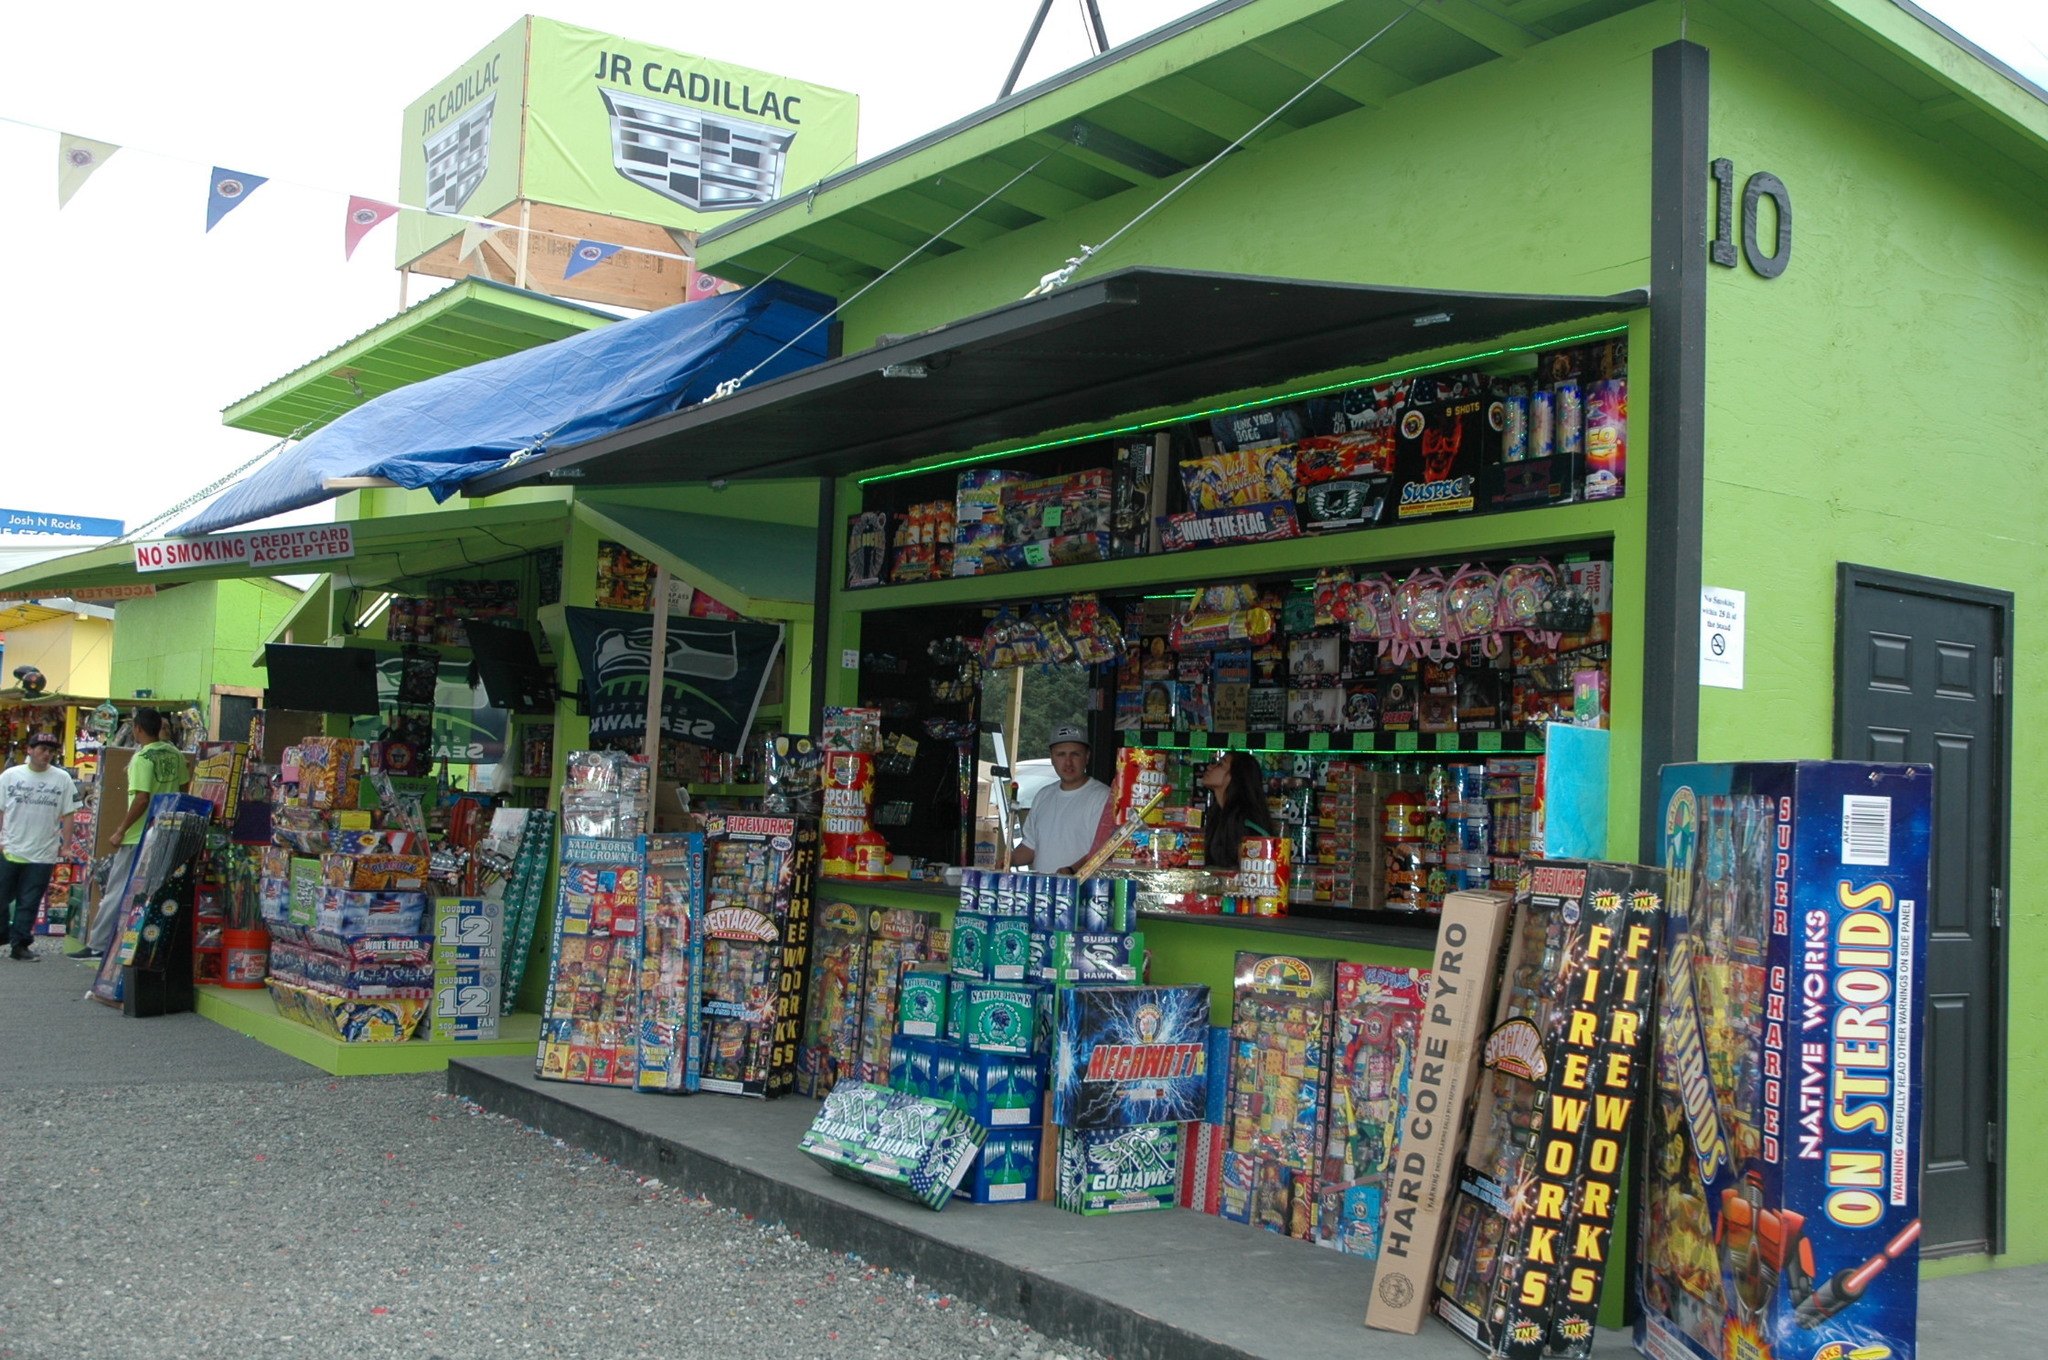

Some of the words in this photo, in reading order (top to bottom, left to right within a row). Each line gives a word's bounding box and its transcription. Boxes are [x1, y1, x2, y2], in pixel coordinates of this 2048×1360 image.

[422, 106, 436, 136] JR
[438, 54, 500, 124] CADILLAC
[595, 51, 632, 86] JR
[642, 62, 801, 125] CADILLAC
[1709, 157, 1792, 279] 10
[1234, 418, 1252, 431] JUNK
[1252, 412, 1274, 426] YARD
[1446, 408, 1452, 416] 9
[1455, 402, 1480, 415] SHOTS
[1400, 477, 1475, 504] SUSPEC
[9, 514, 33, 525] Josh
[37, 517, 48, 527] N
[51, 519, 81, 530] Rocks
[1181, 519, 1214, 541] WAVE
[1214, 516, 1237, 538] THE
[1238, 512, 1267, 535] FLAG
[250, 531, 305, 550] CREDIT
[309, 527, 349, 543] CARD
[253, 540, 350, 563] ACCEPTED
[137, 546, 163, 568] NO
[166, 538, 246, 565] SMOKING
[824, 789, 865, 807] SPECIAL
[726, 815, 795, 836] FIREWORKS
[565, 849, 587, 859] ALL
[590, 851, 627, 862] GROWN
[568, 840, 634, 852] NATIVEWORKS
[1773, 797, 1791, 936] SUPER
[442, 906, 476, 914] LOUDEST
[1595, 896, 1616, 907] TNT
[1635, 896, 1656, 907] TNT
[440, 915, 492, 946] 12
[703, 907, 780, 943] PECTACULAR
[1901, 902, 1911, 933] PANEL
[365, 941, 387, 950] WAVE
[387, 940, 401, 950] THE
[401, 940, 419, 949] FLAG
[479, 948, 496, 957] FAN
[772, 850, 805, 1066] FIREWORKS
[785, 849, 814, 1064] FIREWORKS
[1901, 935, 1910, 957] SIDE
[549, 959, 557, 981] ALL
[1802, 910, 1828, 1030] WORKS
[1900, 959, 1908, 972] ON
[440, 976, 473, 985] LOUDEST
[691, 947, 701, 1033] FIREWORKS
[438, 986, 490, 1017] 12
[545, 984, 555, 1020] GROWN
[1005, 992, 1032, 1008] HAWK
[1832, 881, 1894, 1133] STEROIDS
[1898, 975, 1909, 1024] WARNINGS
[477, 1018, 495, 1027] FAN
[1898, 1027, 1908, 1059] OTHER
[1086, 1043, 1203, 1082] MEGAWATT
[1764, 966, 1785, 1163] CHARGED
[1897, 1061, 1907, 1088] READ
[987, 1066, 1009, 1091] MAN
[1014, 1065, 1037, 1087] CAVE
[1387, 1152, 1425, 1258] HARD
[1411, 1036, 1448, 1140] CORE
[1430, 922, 1467, 1026] PYRO
[1799, 1042, 1826, 1158] NATIVE
[1519, 924, 1612, 1307] FIREWORKS
[1569, 925, 1650, 1303] FIREWORKS
[1895, 1090, 1906, 1144] CAREFULLY
[812, 1118, 829, 1132] GO
[827, 1122, 866, 1142] HAWKS
[866, 1135, 883, 1150] GO
[881, 1140, 923, 1159] HAWKS
[939, 1167, 953, 1184] GO
[949, 1137, 971, 1168] HAWK
[984, 1141, 1006, 1166] MAN
[1011, 1140, 1034, 1162] CAVE
[1065, 1140, 1072, 1155] GO
[1092, 1173, 1118, 1190] GO
[1121, 1170, 1175, 1188] HAWKS
[1893, 1149, 1904, 1201] WARNING
[1827, 1152, 1884, 1227] ON
[1514, 1326, 1537, 1339] TNT
[1563, 1324, 1587, 1336] TNT
